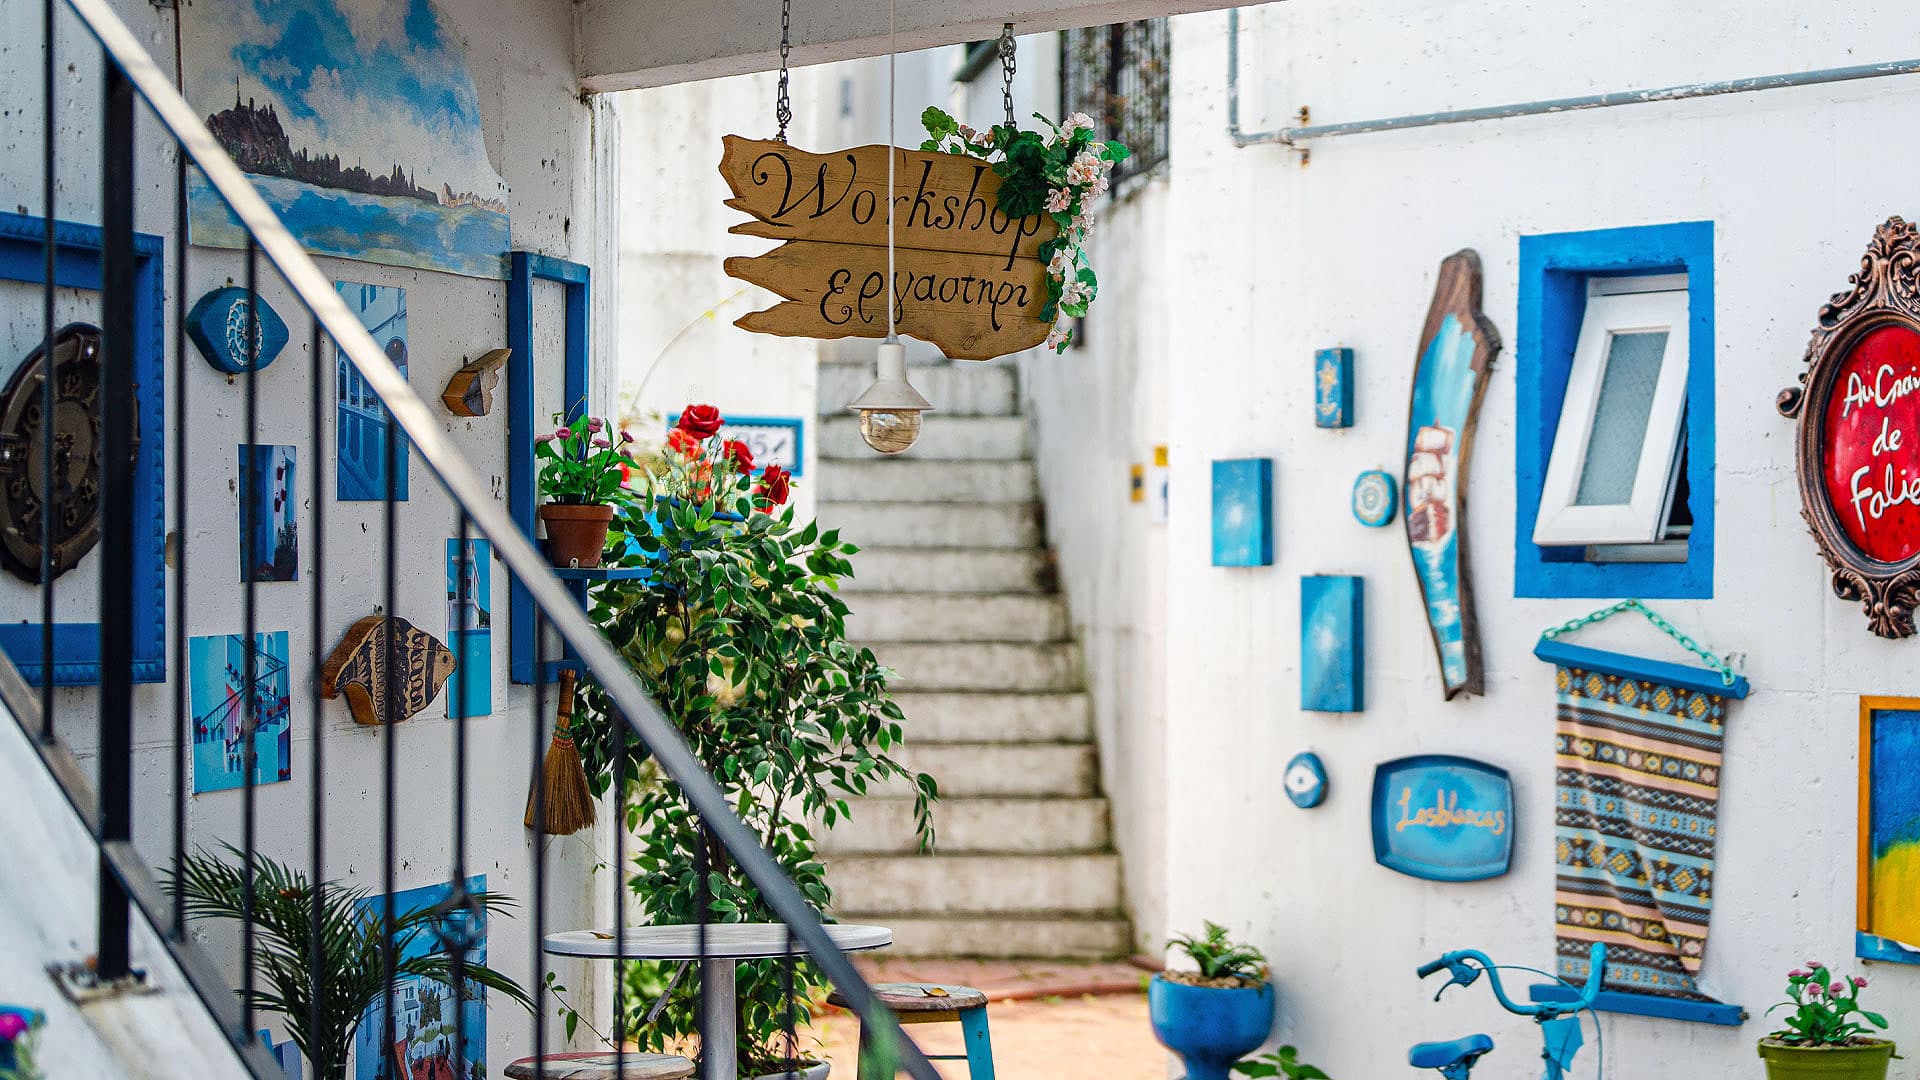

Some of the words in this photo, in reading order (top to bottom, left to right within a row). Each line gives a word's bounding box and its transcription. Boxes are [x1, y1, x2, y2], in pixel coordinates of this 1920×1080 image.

[751, 152, 1041, 271] Workshop
[1842, 372, 1875, 418] Au
[1872, 416, 1902, 457] de
